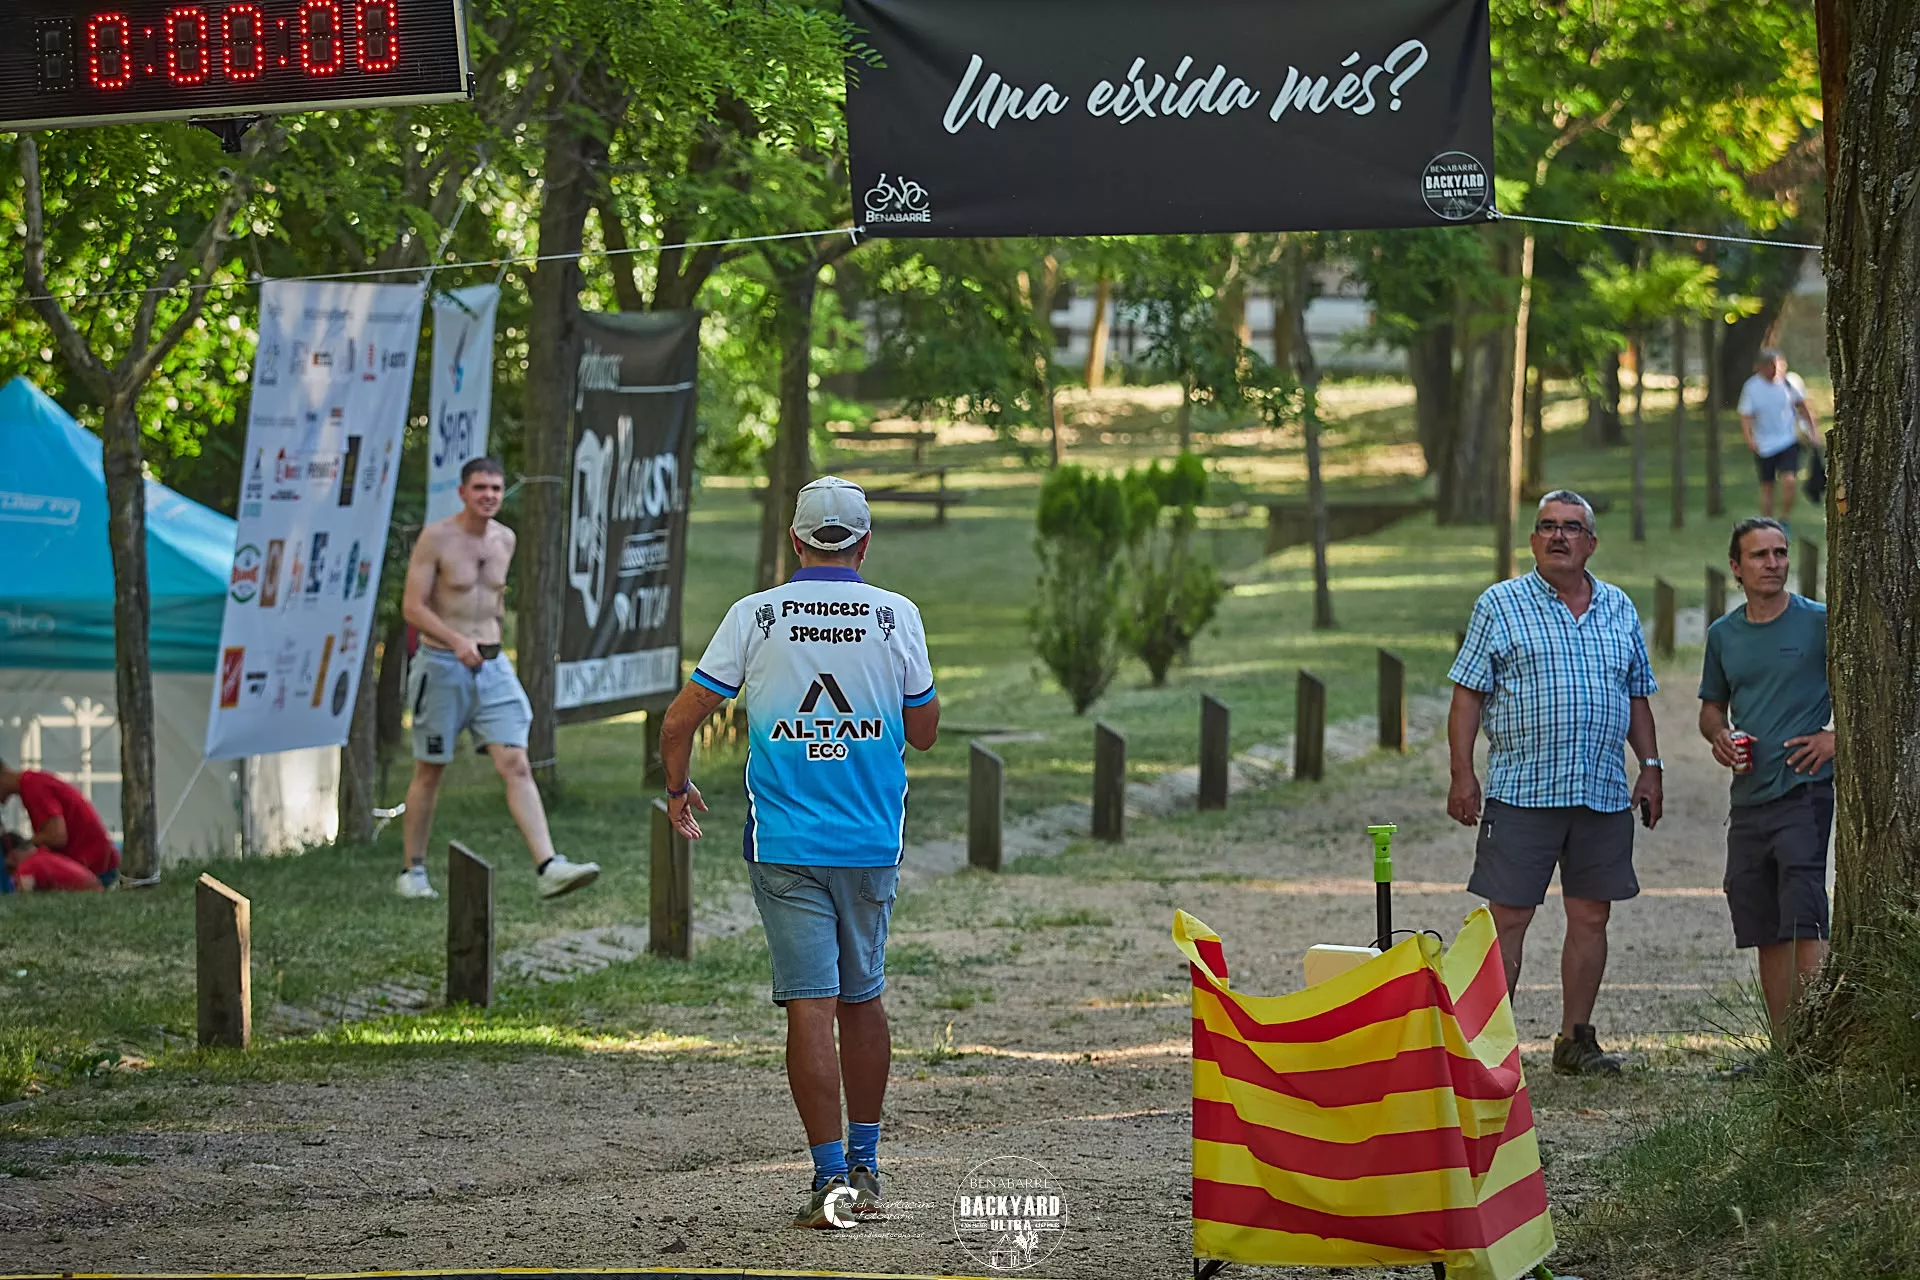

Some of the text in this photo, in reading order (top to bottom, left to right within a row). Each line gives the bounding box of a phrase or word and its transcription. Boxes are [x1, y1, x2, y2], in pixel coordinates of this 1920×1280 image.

[88, 0, 399, 89] 0:00:00
[942, 38, 1429, 134] Una eixida més?
[1430, 163, 1479, 173] BENABARRE
[1425, 173, 1484, 190] BACKYARD
[1443, 188, 1468, 198] ULTRA
[781, 600, 870, 618] Francesc
[771, 719, 883, 740] ALTAN
[807, 743, 848, 760] ECO
